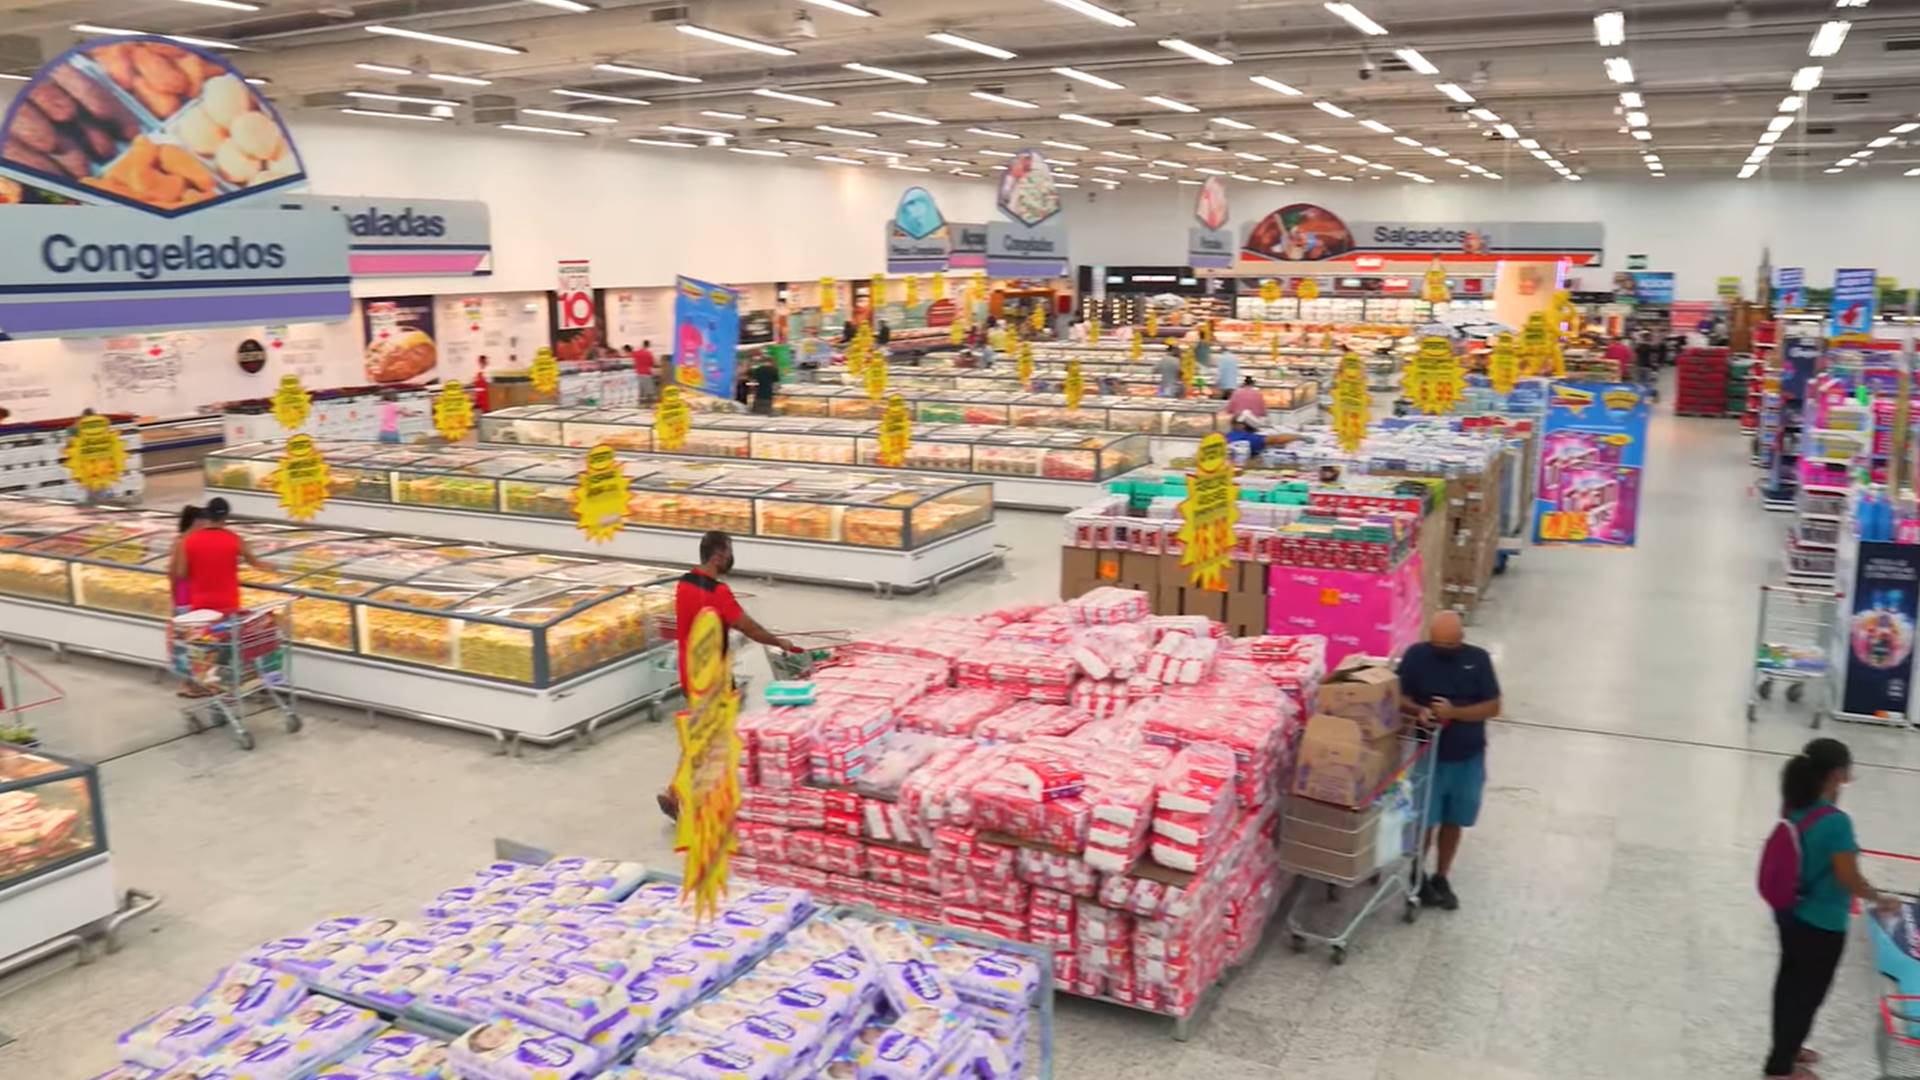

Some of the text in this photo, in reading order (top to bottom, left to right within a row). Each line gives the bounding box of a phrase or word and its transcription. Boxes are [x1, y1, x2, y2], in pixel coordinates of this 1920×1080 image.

[281, 204, 446, 238] aladas
[1373, 225, 1468, 247] Salgados
[41, 233, 286, 280] Congelados
[558, 291, 594, 327] 10
